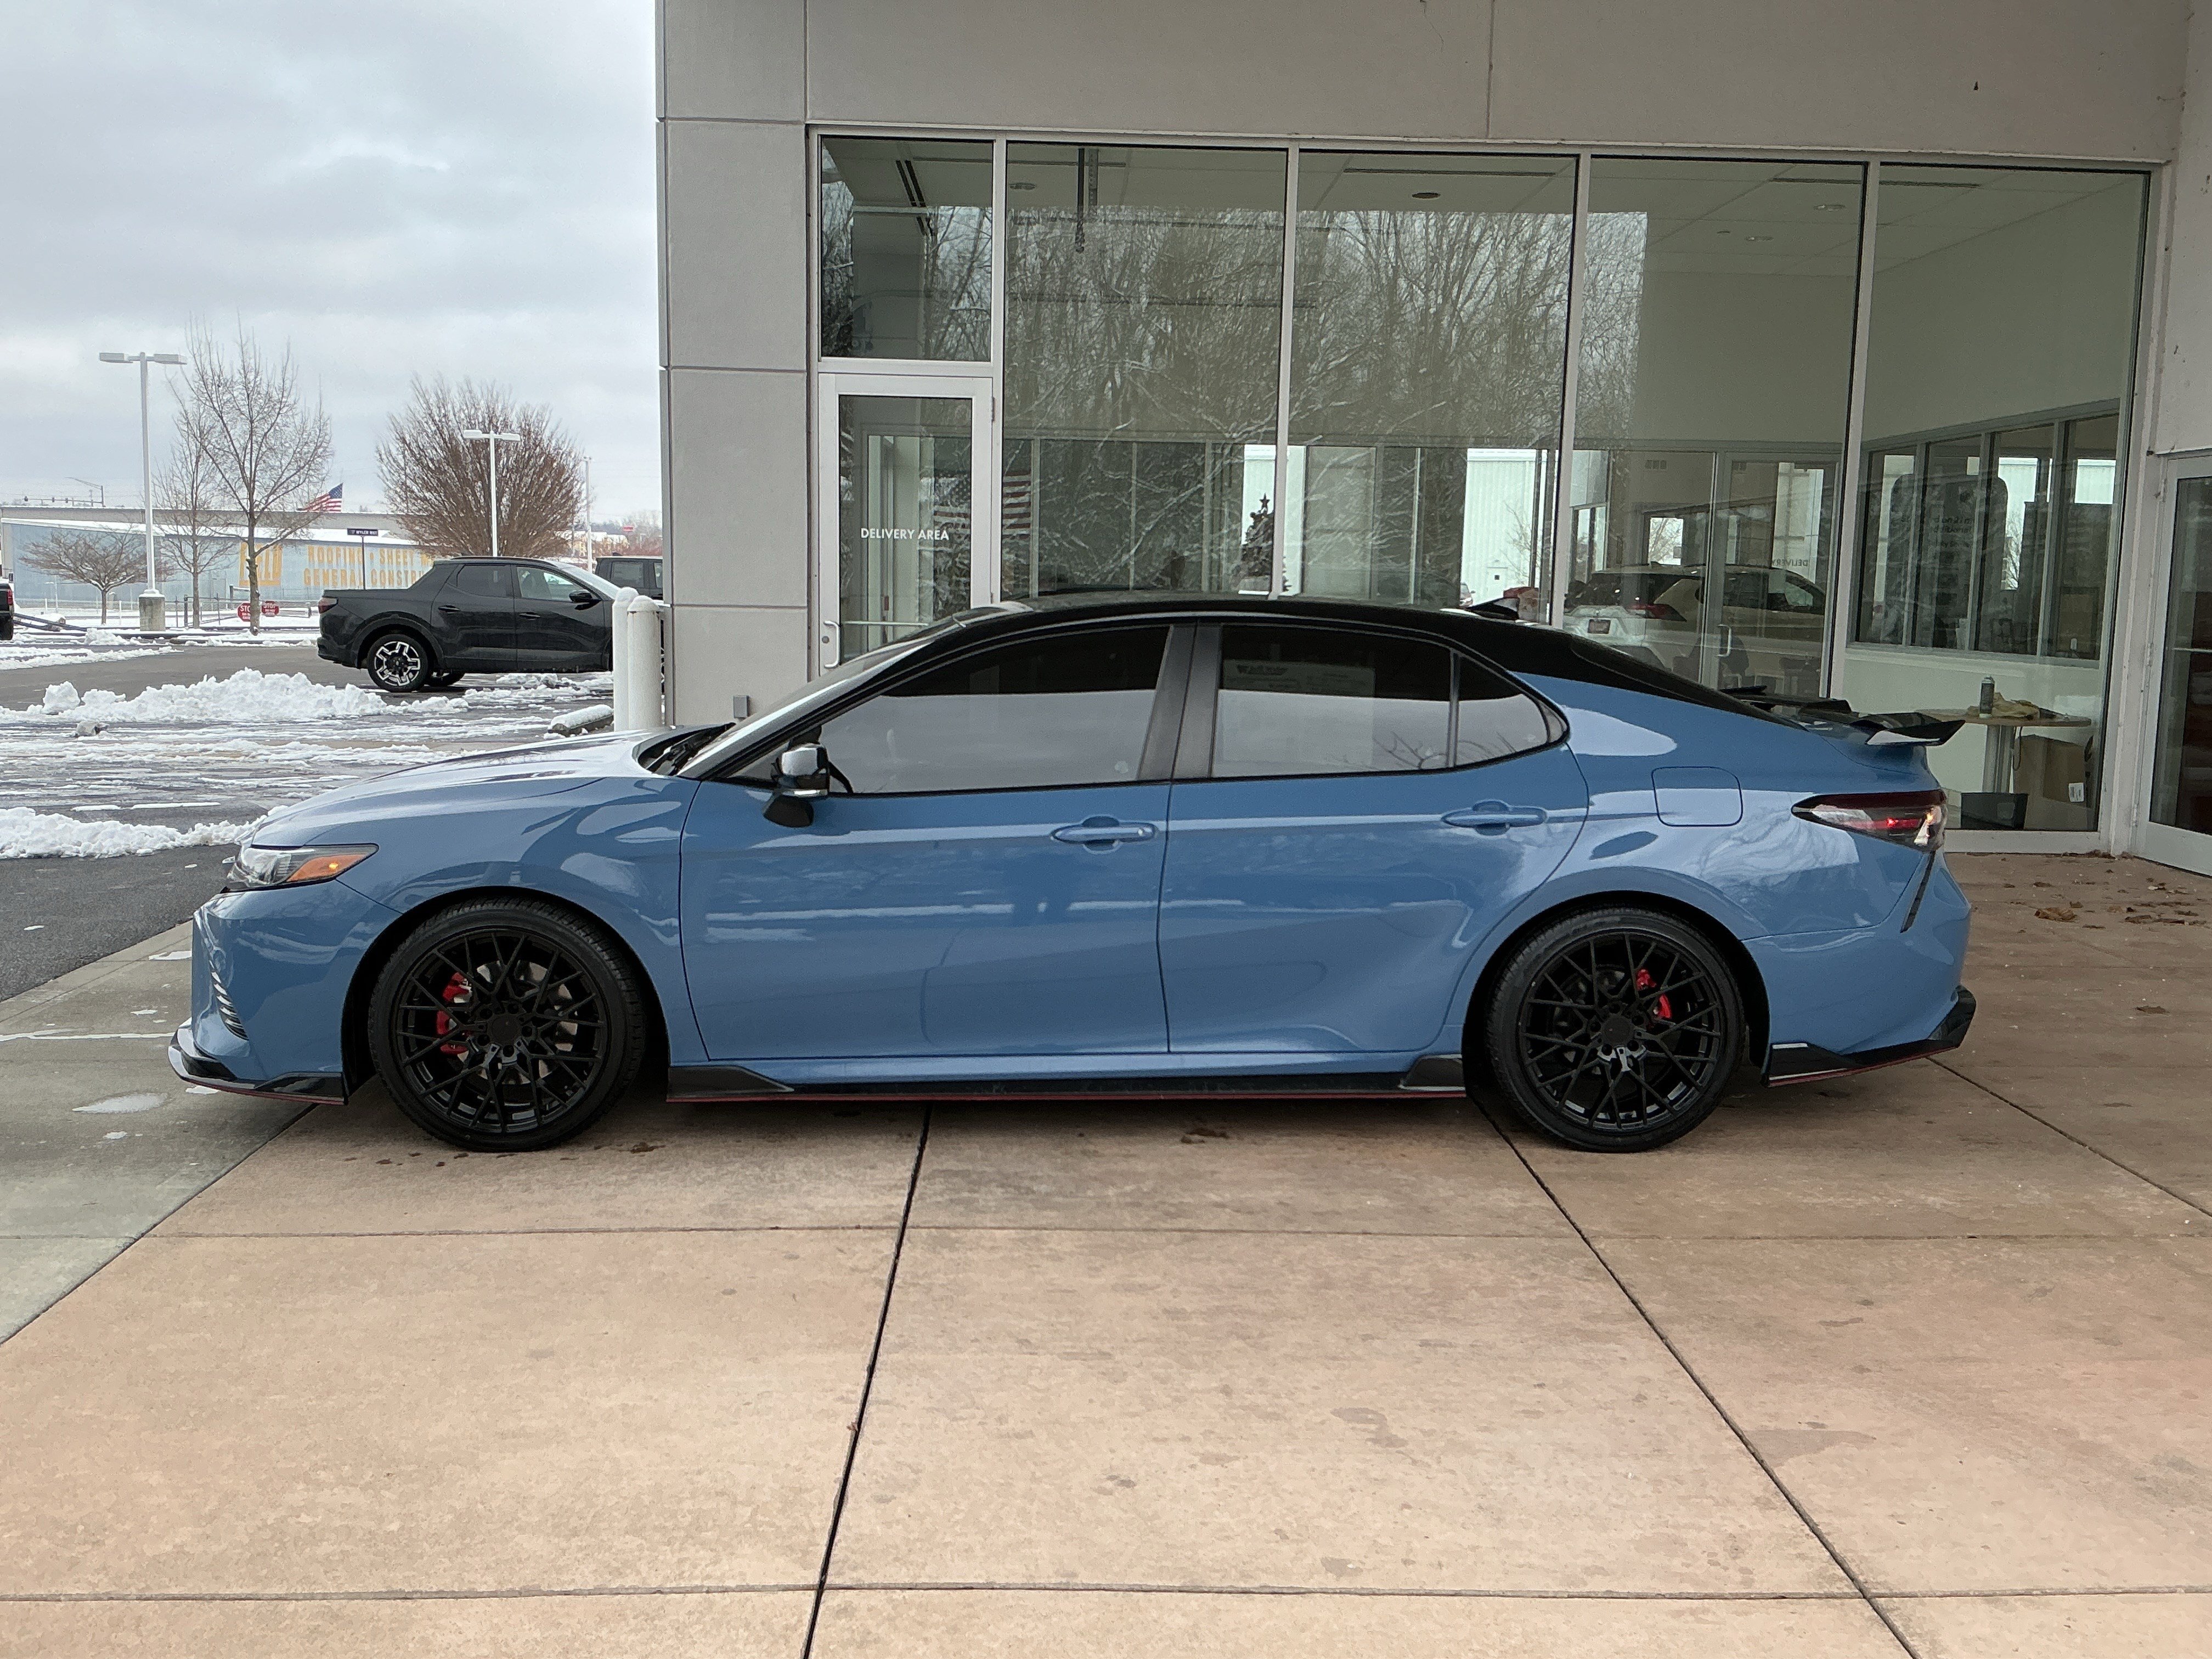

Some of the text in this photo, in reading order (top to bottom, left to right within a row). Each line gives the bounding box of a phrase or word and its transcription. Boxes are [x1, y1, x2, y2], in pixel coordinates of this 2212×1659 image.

[860, 528, 950, 541] DELIVERY AREA
[239, 542, 283, 580] FELD
[308, 545, 363, 565] ROOFING
[379, 548, 415, 566] SHEET
[304, 568, 363, 586] GENERAL
